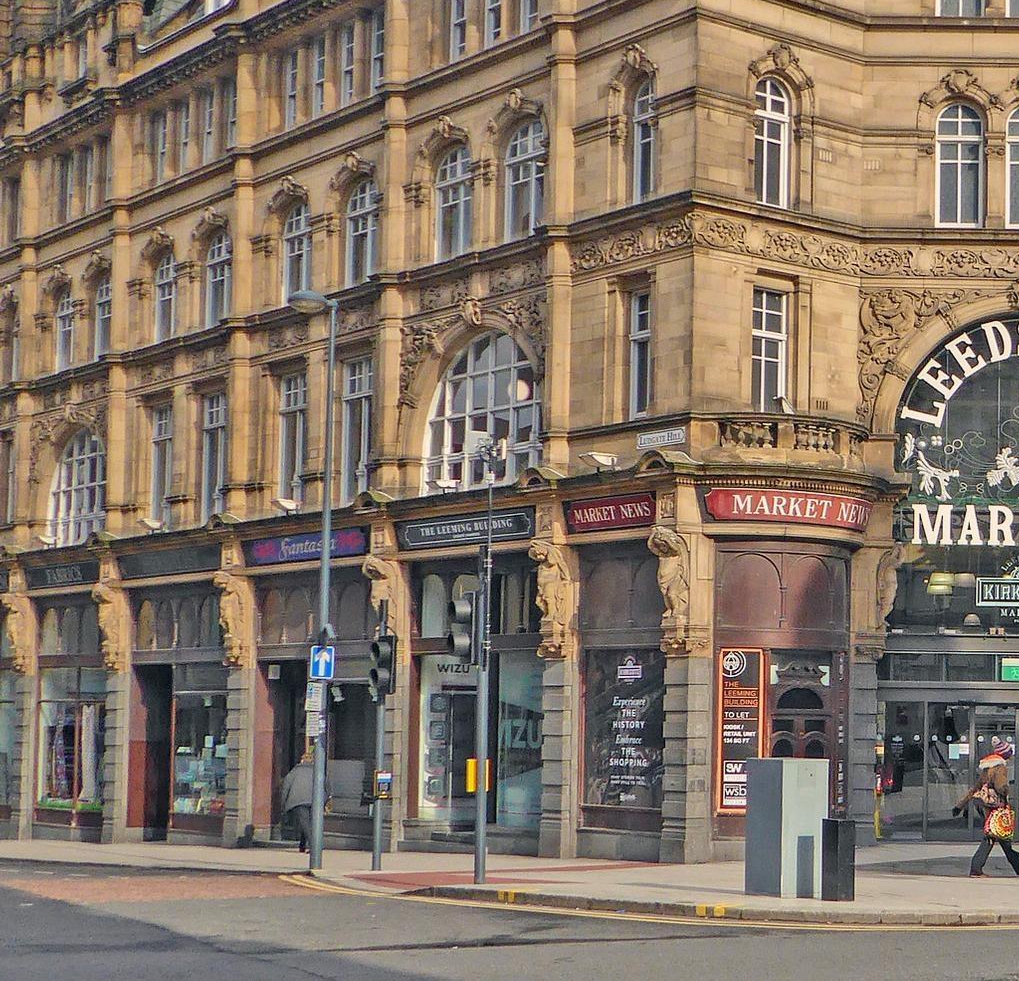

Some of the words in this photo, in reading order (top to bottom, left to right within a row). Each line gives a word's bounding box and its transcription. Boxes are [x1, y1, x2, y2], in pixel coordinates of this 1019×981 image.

[574, 505, 615, 523] MARKET
[619, 501, 651, 519] NEWS
[732, 494, 832, 519] MARKET
[837, 502, 871, 526] NEWS
[420, 527, 436, 537] THE
[437, 523, 472, 535] LEEMING
[437, 664, 470, 674] WIZU
[612, 696, 646, 709] Experience
[621, 708, 637, 718] THE
[612, 720, 645, 729] HISTORY
[615, 734, 642, 745] Embrace
[621, 747, 636, 756] THE
[609, 757, 648, 767] SHOPPING
